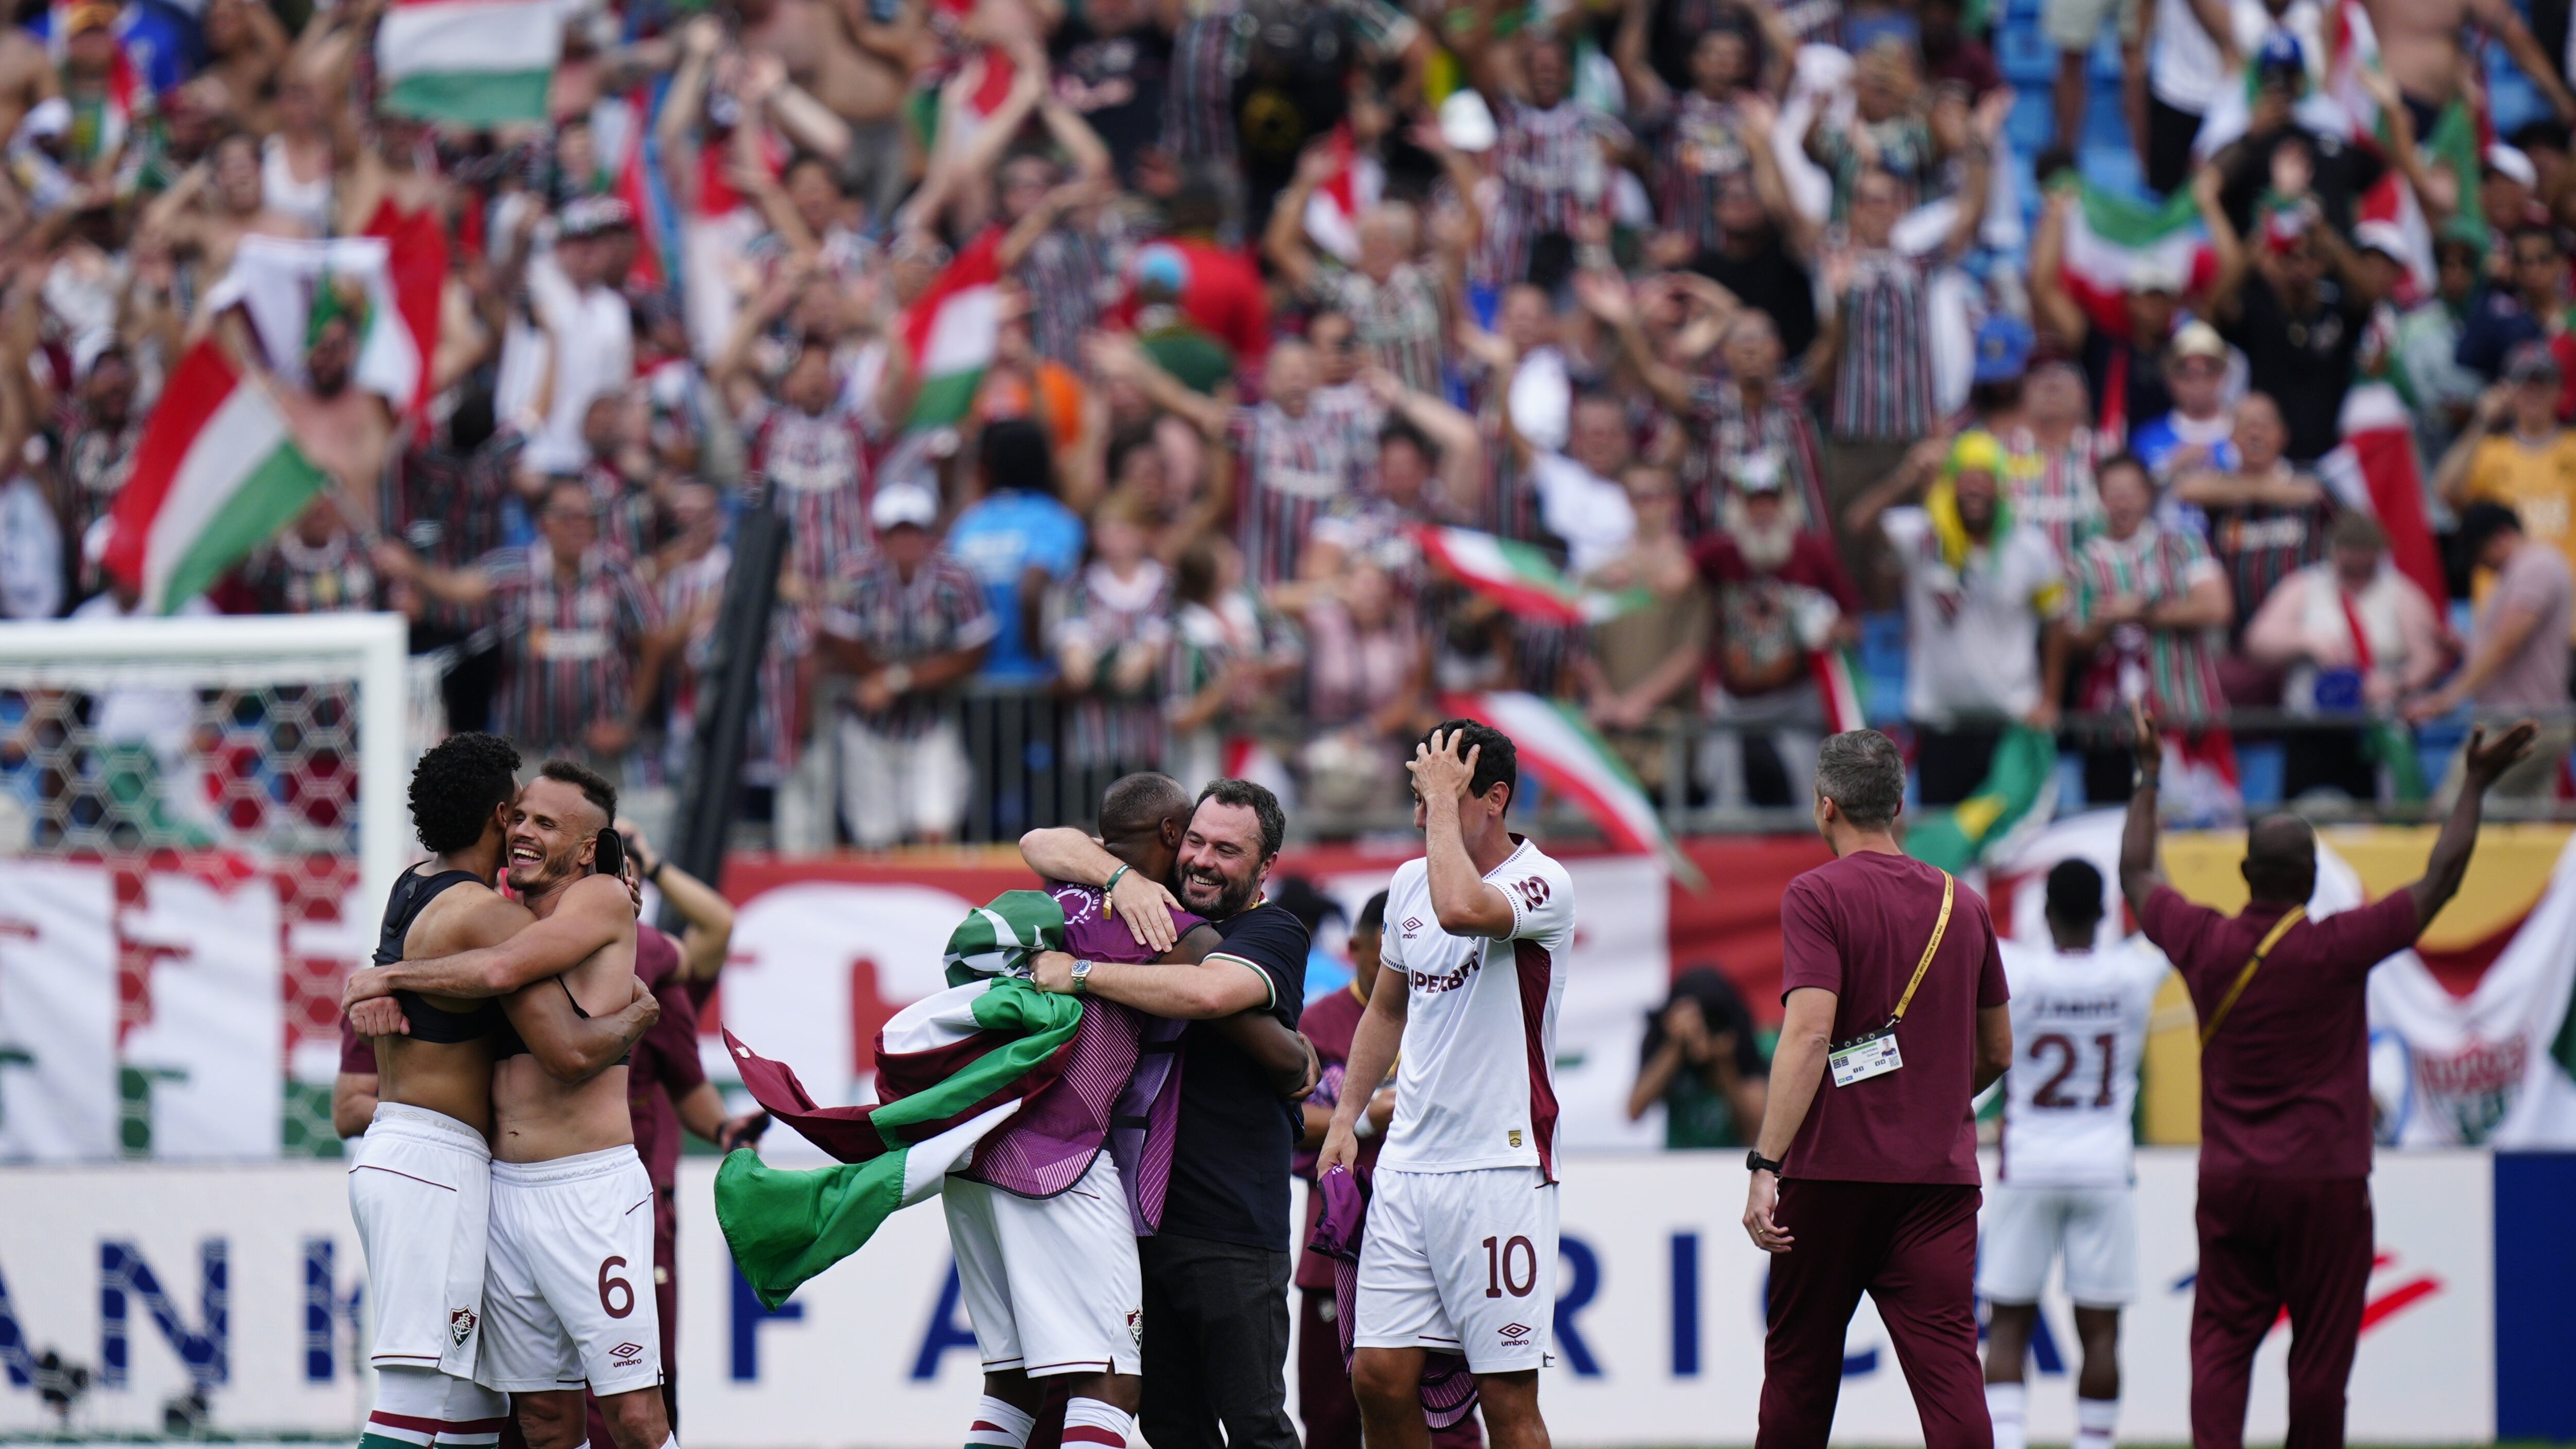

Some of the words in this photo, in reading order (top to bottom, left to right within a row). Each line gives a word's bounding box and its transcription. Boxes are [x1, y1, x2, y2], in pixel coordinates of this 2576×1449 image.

[2029, 1032, 2114, 1107] 21
[598, 1255, 635, 1319] 6
[1482, 1235, 1537, 1299] 10
[613, 1358, 642, 1368] umbro
